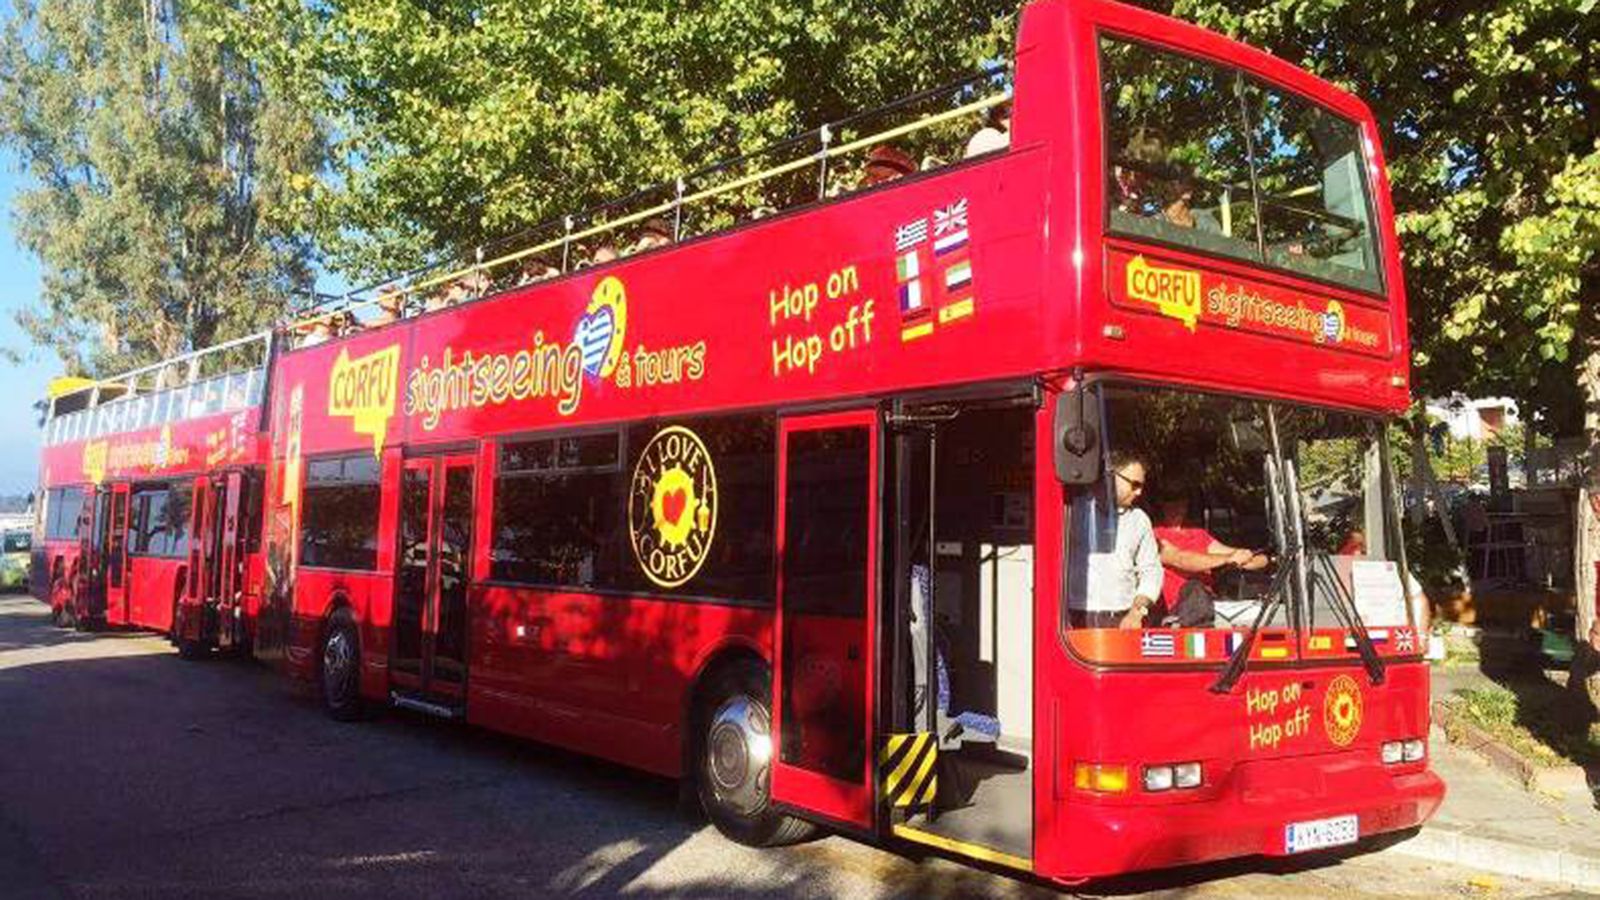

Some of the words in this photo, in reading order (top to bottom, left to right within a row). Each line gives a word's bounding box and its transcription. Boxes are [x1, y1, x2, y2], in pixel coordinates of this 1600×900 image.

[769, 283, 819, 327] Hop
[826, 264, 859, 299] on
[1132, 269, 1196, 307] CORFU
[1208, 283, 1326, 343] sightseeing
[772, 334, 822, 377] Hop
[829, 299, 876, 352] off
[333, 351, 393, 409] CORFU
[403, 331, 585, 431] sightseeing
[634, 340, 706, 388] tours
[657, 434, 703, 474] LOVE
[639, 533, 703, 579] CORFU
[1246, 689, 1280, 715] Hop
[1282, 681, 1302, 704] on
[1249, 720, 1283, 750] Hop
[1284, 705, 1311, 738] off
